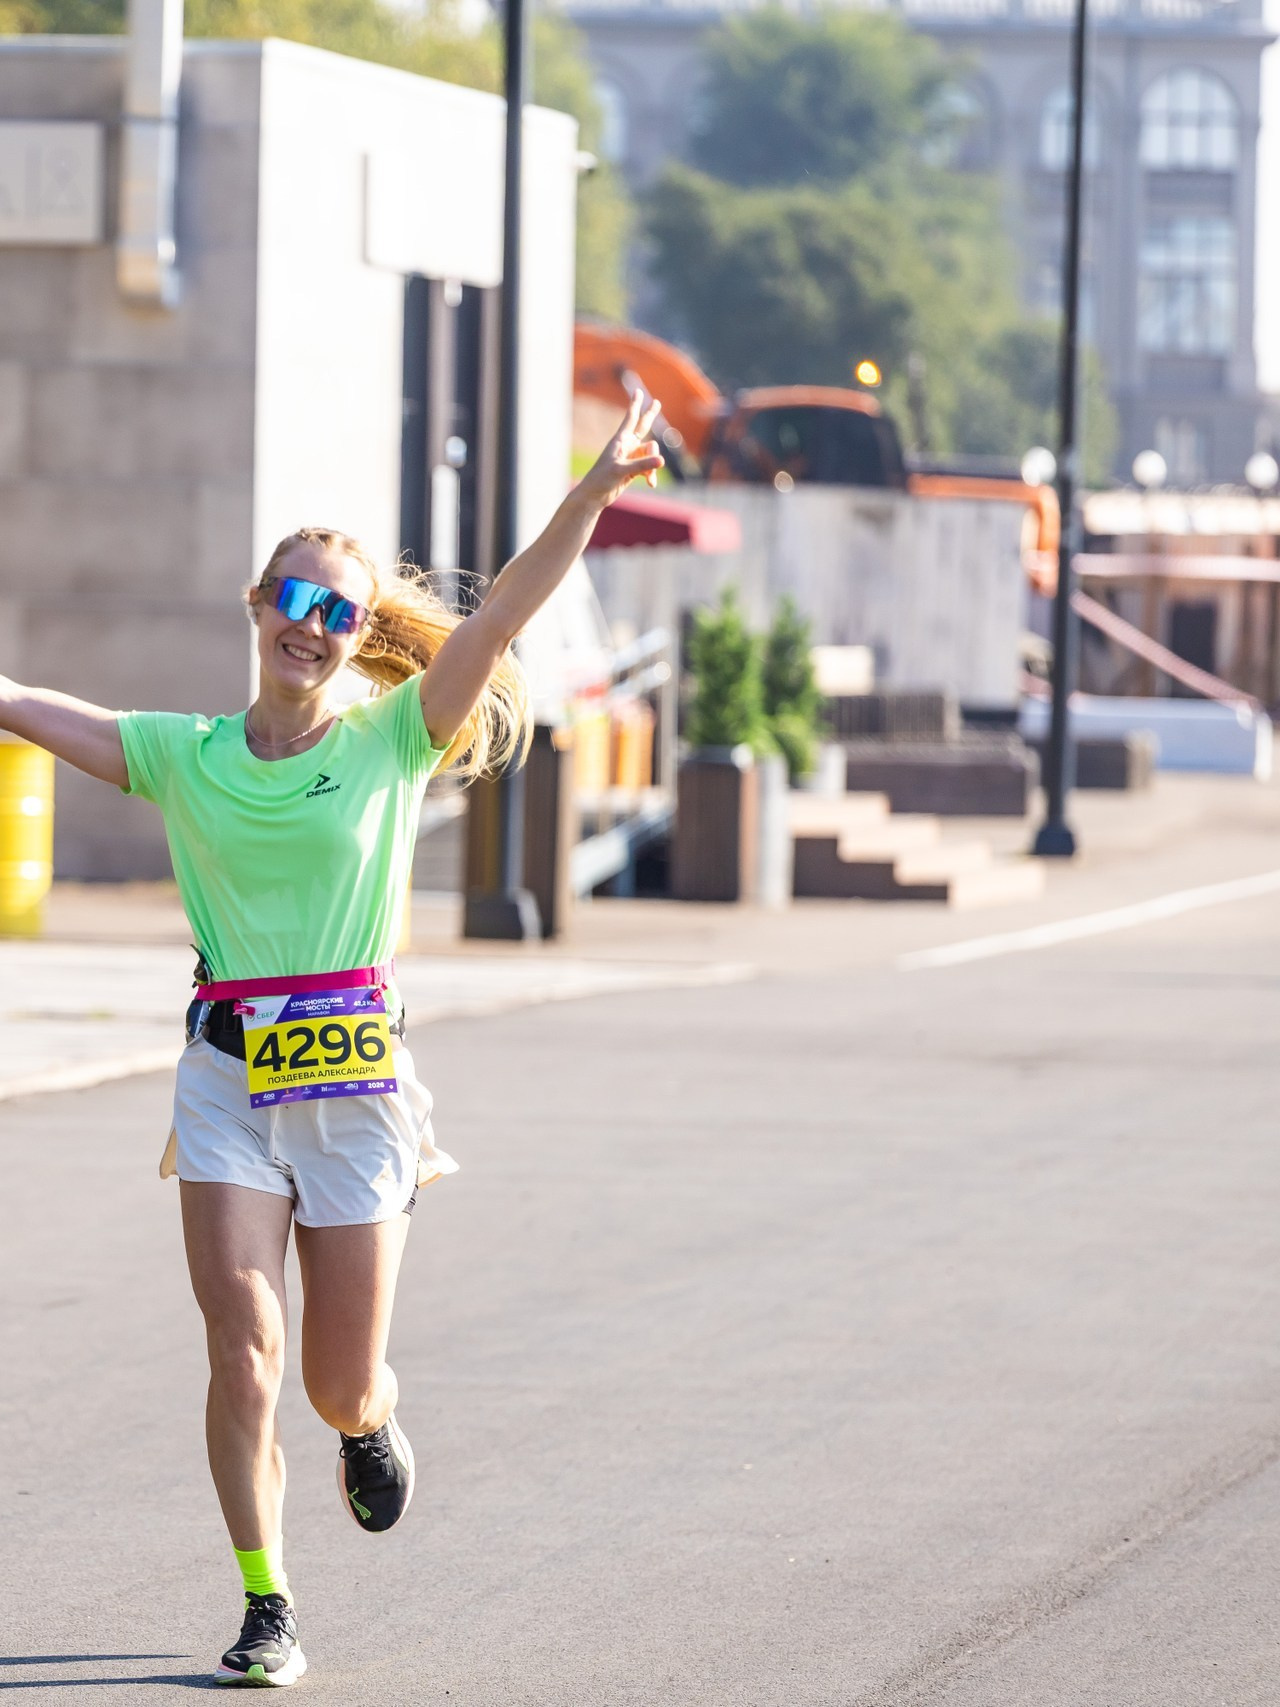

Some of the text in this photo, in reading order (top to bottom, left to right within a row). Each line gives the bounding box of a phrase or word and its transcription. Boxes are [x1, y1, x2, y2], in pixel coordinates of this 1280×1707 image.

[306, 784, 341, 798] DEMIX
[290, 997, 343, 1008] КРАСНОЯРСКИЕ
[256, 1011, 275, 1020] СБЕР
[252, 1021, 387, 1073] 4296
[267, 1065, 377, 1085] ПОЗДЕЕВА АЛЕКСАНДРА
